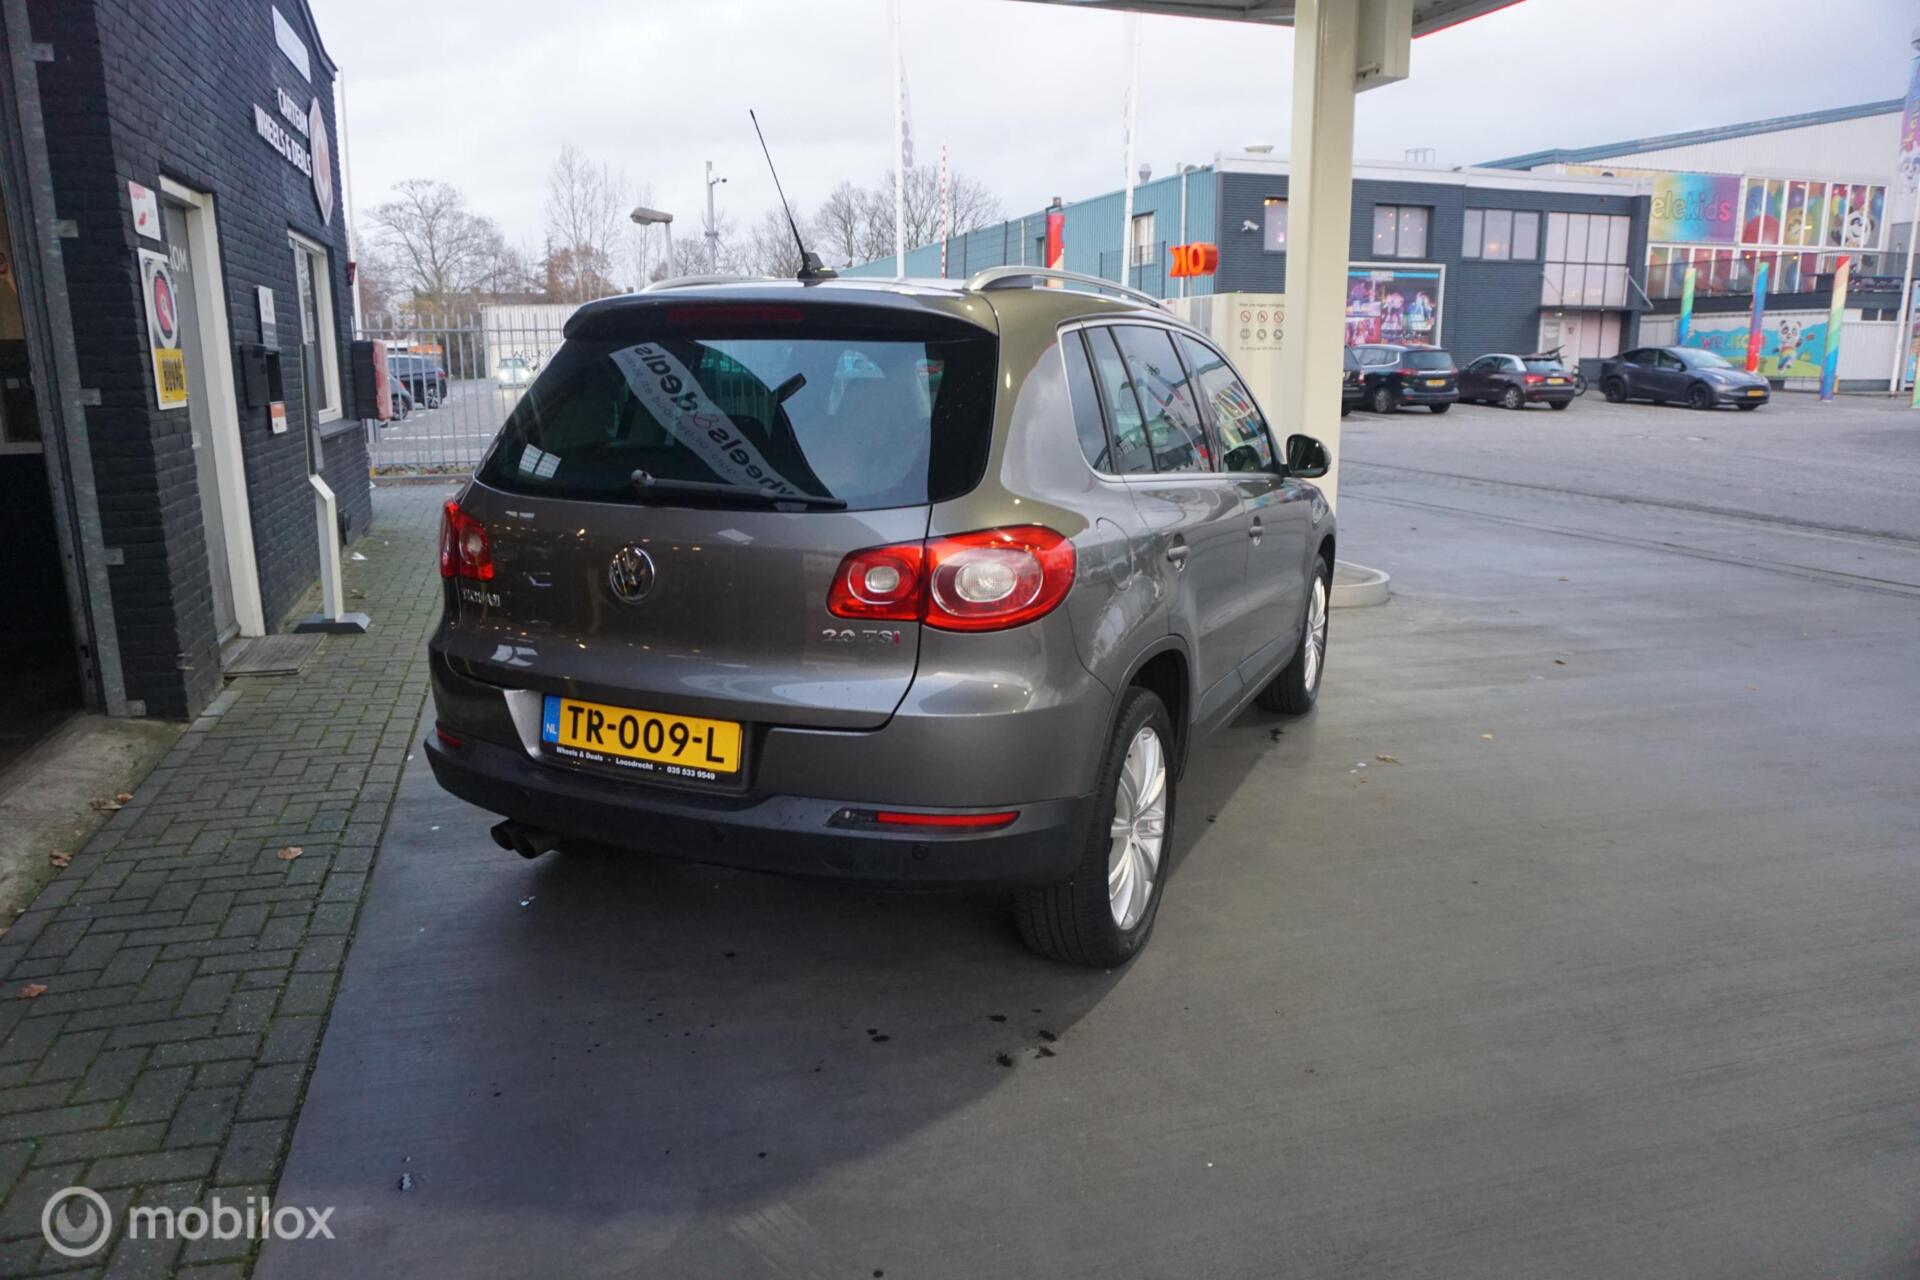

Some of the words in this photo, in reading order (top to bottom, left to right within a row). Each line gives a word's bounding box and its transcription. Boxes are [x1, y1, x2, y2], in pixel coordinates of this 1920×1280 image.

[253, 103, 286, 156] WHEELS
[291, 138, 312, 178] DEALS
[546, 723, 557, 735] NL
[567, 705, 725, 764] TR-009-L
[556, 746, 578, 758] Wheels
[586, 752, 604, 762] Deals
[616, 757, 654, 771] Loosdrecht
